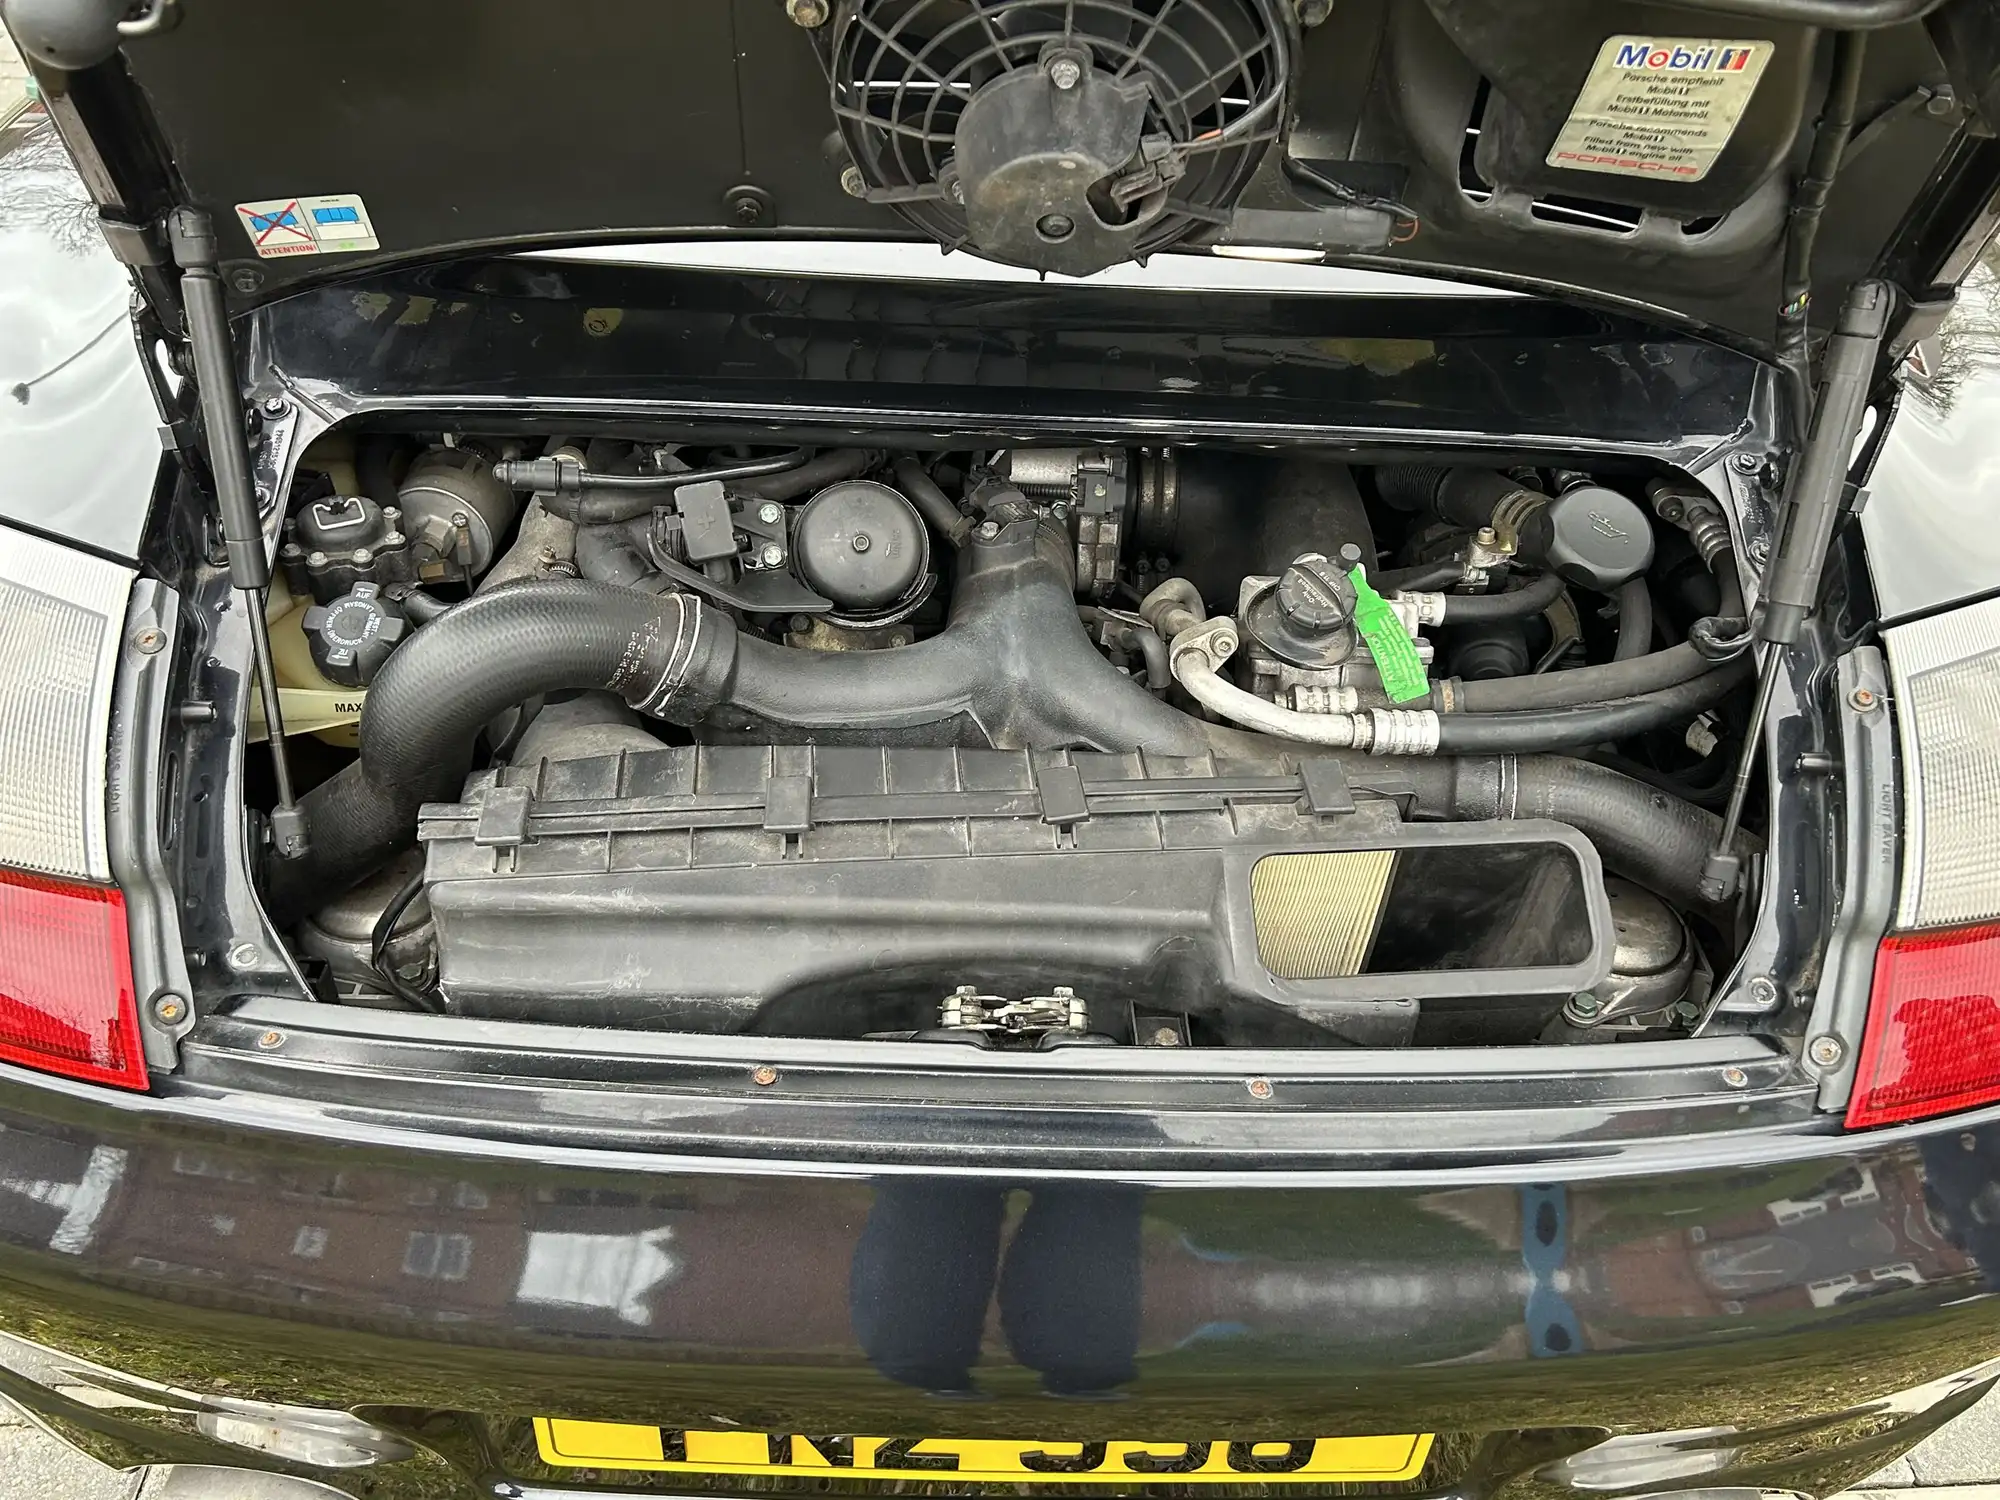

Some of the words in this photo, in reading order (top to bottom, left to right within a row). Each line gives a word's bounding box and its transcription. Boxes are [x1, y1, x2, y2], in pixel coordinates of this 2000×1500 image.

[1616, 45, 1714, 69] Mobil
[1622, 72, 1667, 84] Porsche
[1671, 75, 1724, 87] empfiehlt
[1646, 86, 1677, 96] Mobil
[1615, 94, 1688, 108] Erstbefüllung
[1691, 99, 1711, 108] mit
[1607, 104, 1637, 115] Mobil
[1651, 108, 1709, 119] Motorenöl
[1588, 119, 1633, 131] Porsche
[1635, 125, 1708, 137] recommends
[1623, 132, 1653, 142] Mobil
[1584, 135, 1612, 146] Filled
[1615, 139, 1640, 149] from
[1643, 143, 1667, 152] new
[1670, 145, 1694, 155] with
[1586, 144, 1616, 155] Mobil
[1629, 150, 1666, 161] engine
[1668, 153, 1683, 162] oil
[1556, 152, 1698, 175] PORSCHE
[260, 243, 317, 257] ATTENTION!
[355, 592, 371, 600] AUF
[344, 601, 375, 613] LANGSAM
[337, 648, 349, 656] ZU
[335, 703, 363, 713] MAX
